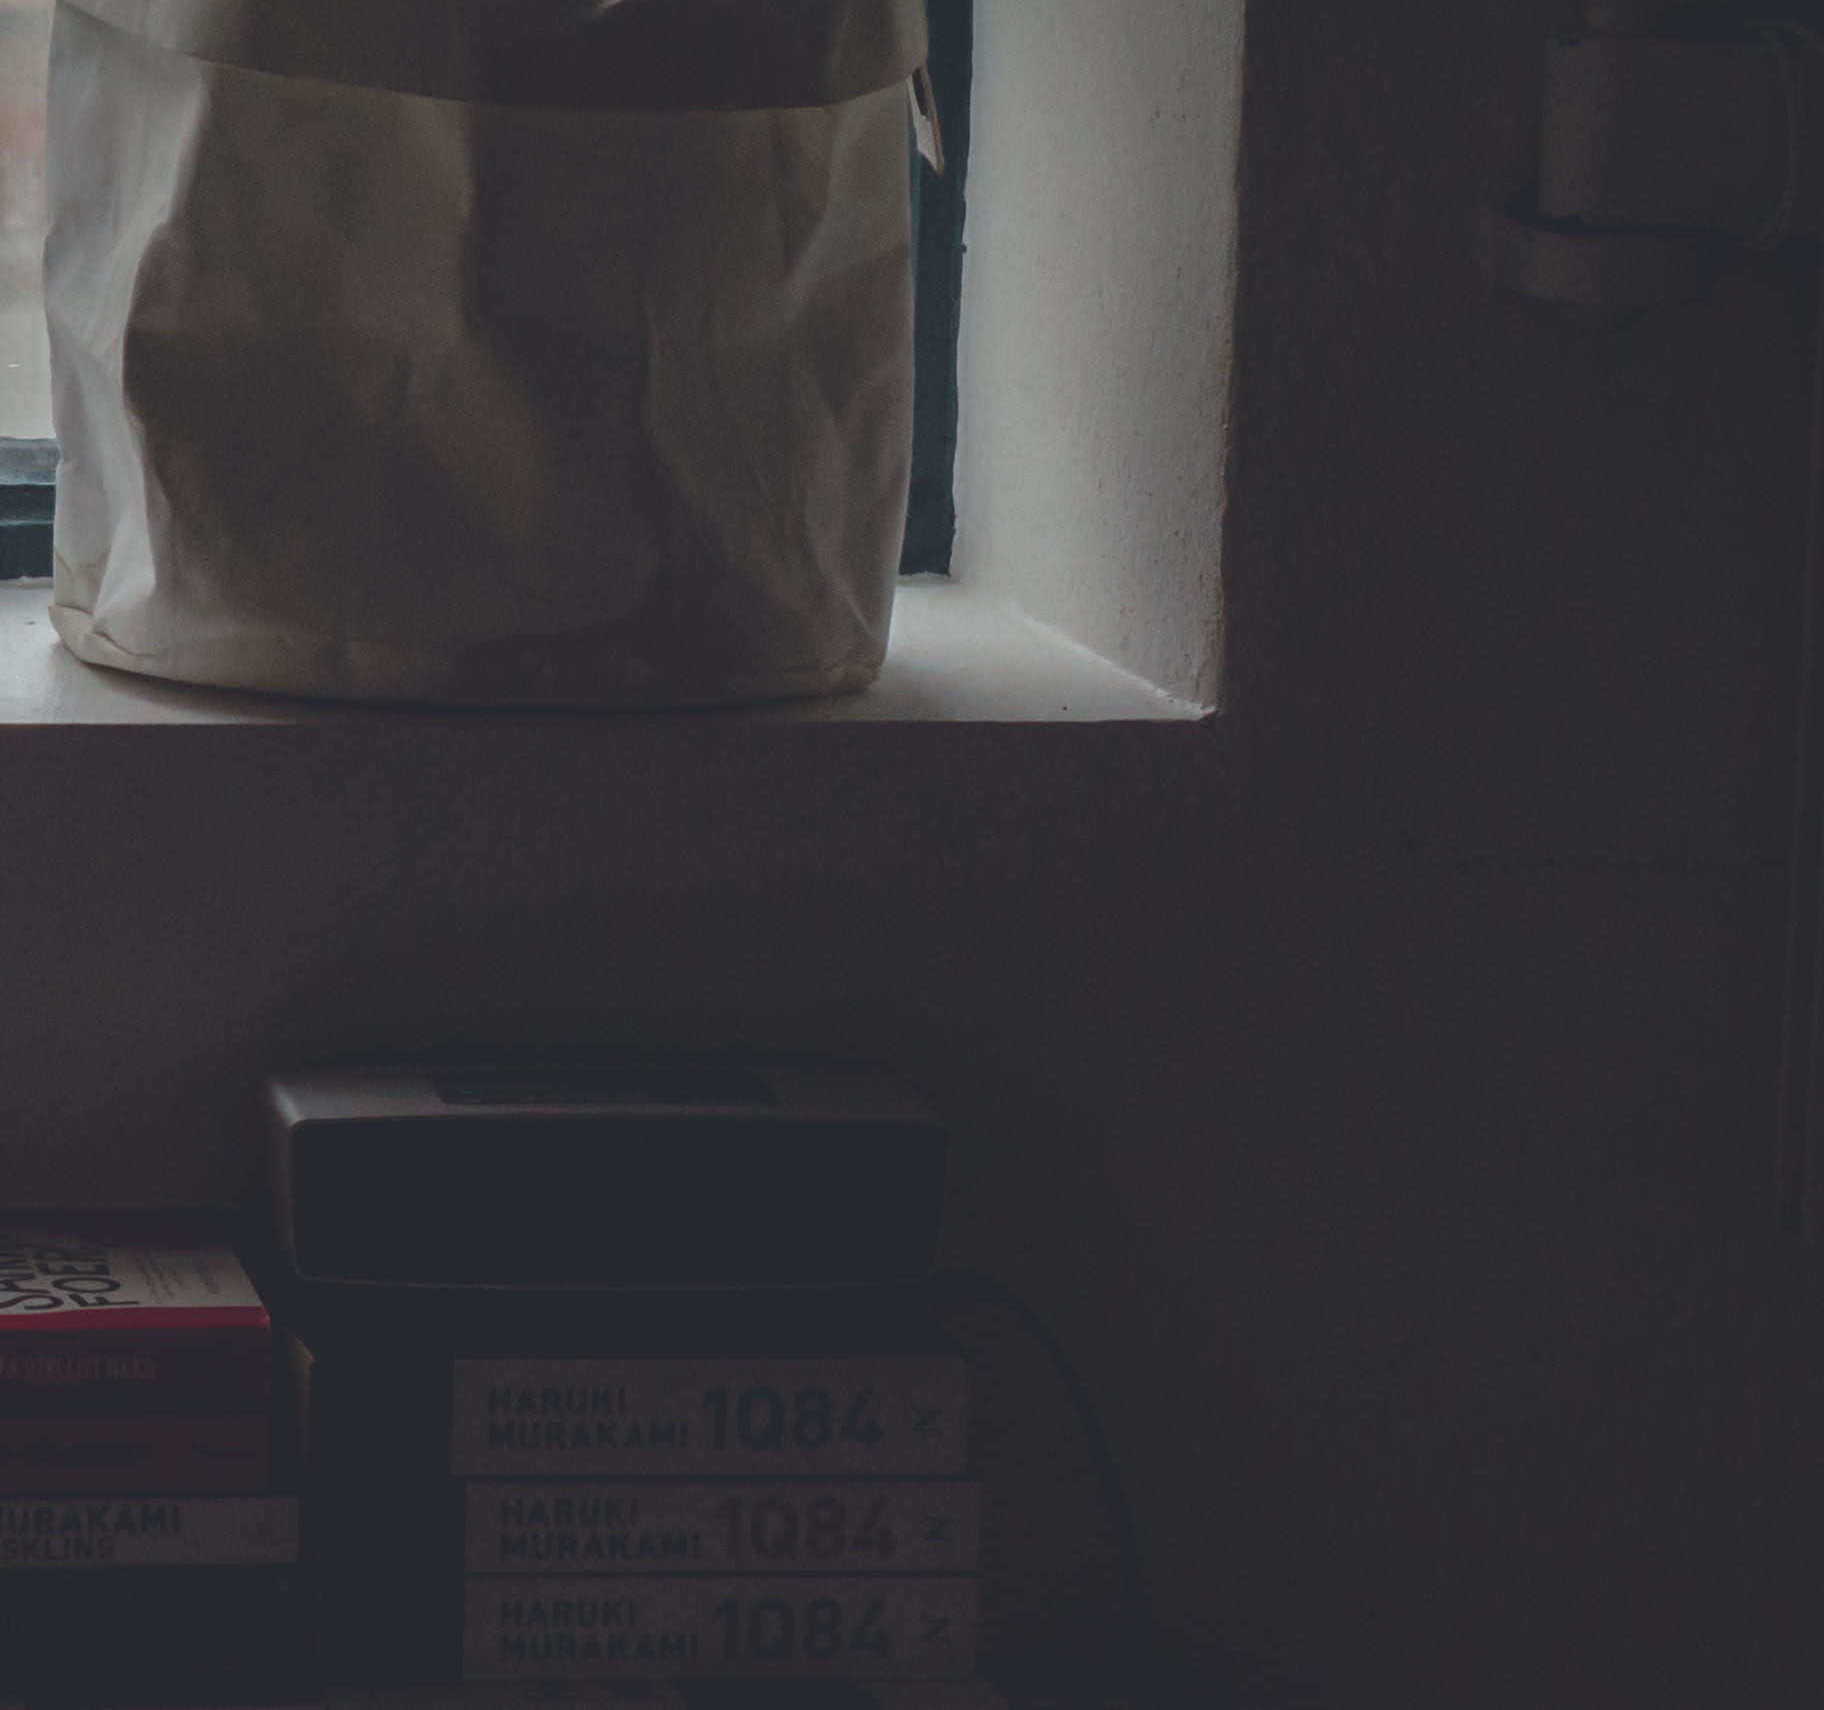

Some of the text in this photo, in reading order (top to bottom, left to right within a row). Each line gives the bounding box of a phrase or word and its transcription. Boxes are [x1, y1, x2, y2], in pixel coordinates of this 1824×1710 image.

[34, 1247, 138, 1307] FOER
[488, 1387, 626, 1415] HARUKI
[701, 1386, 884, 1451] 1Q84
[488, 1421, 687, 1450] MURAKAMI
[501, 1497, 639, 1526] HARUKI
[715, 1496, 898, 1561] 1Q84
[501, 1532, 701, 1561] MURAKAMI
[500, 1599, 638, 1627] HARUKI
[712, 1597, 894, 1662] 1Q84
[499, 1633, 699, 1662] MURAKAMI
